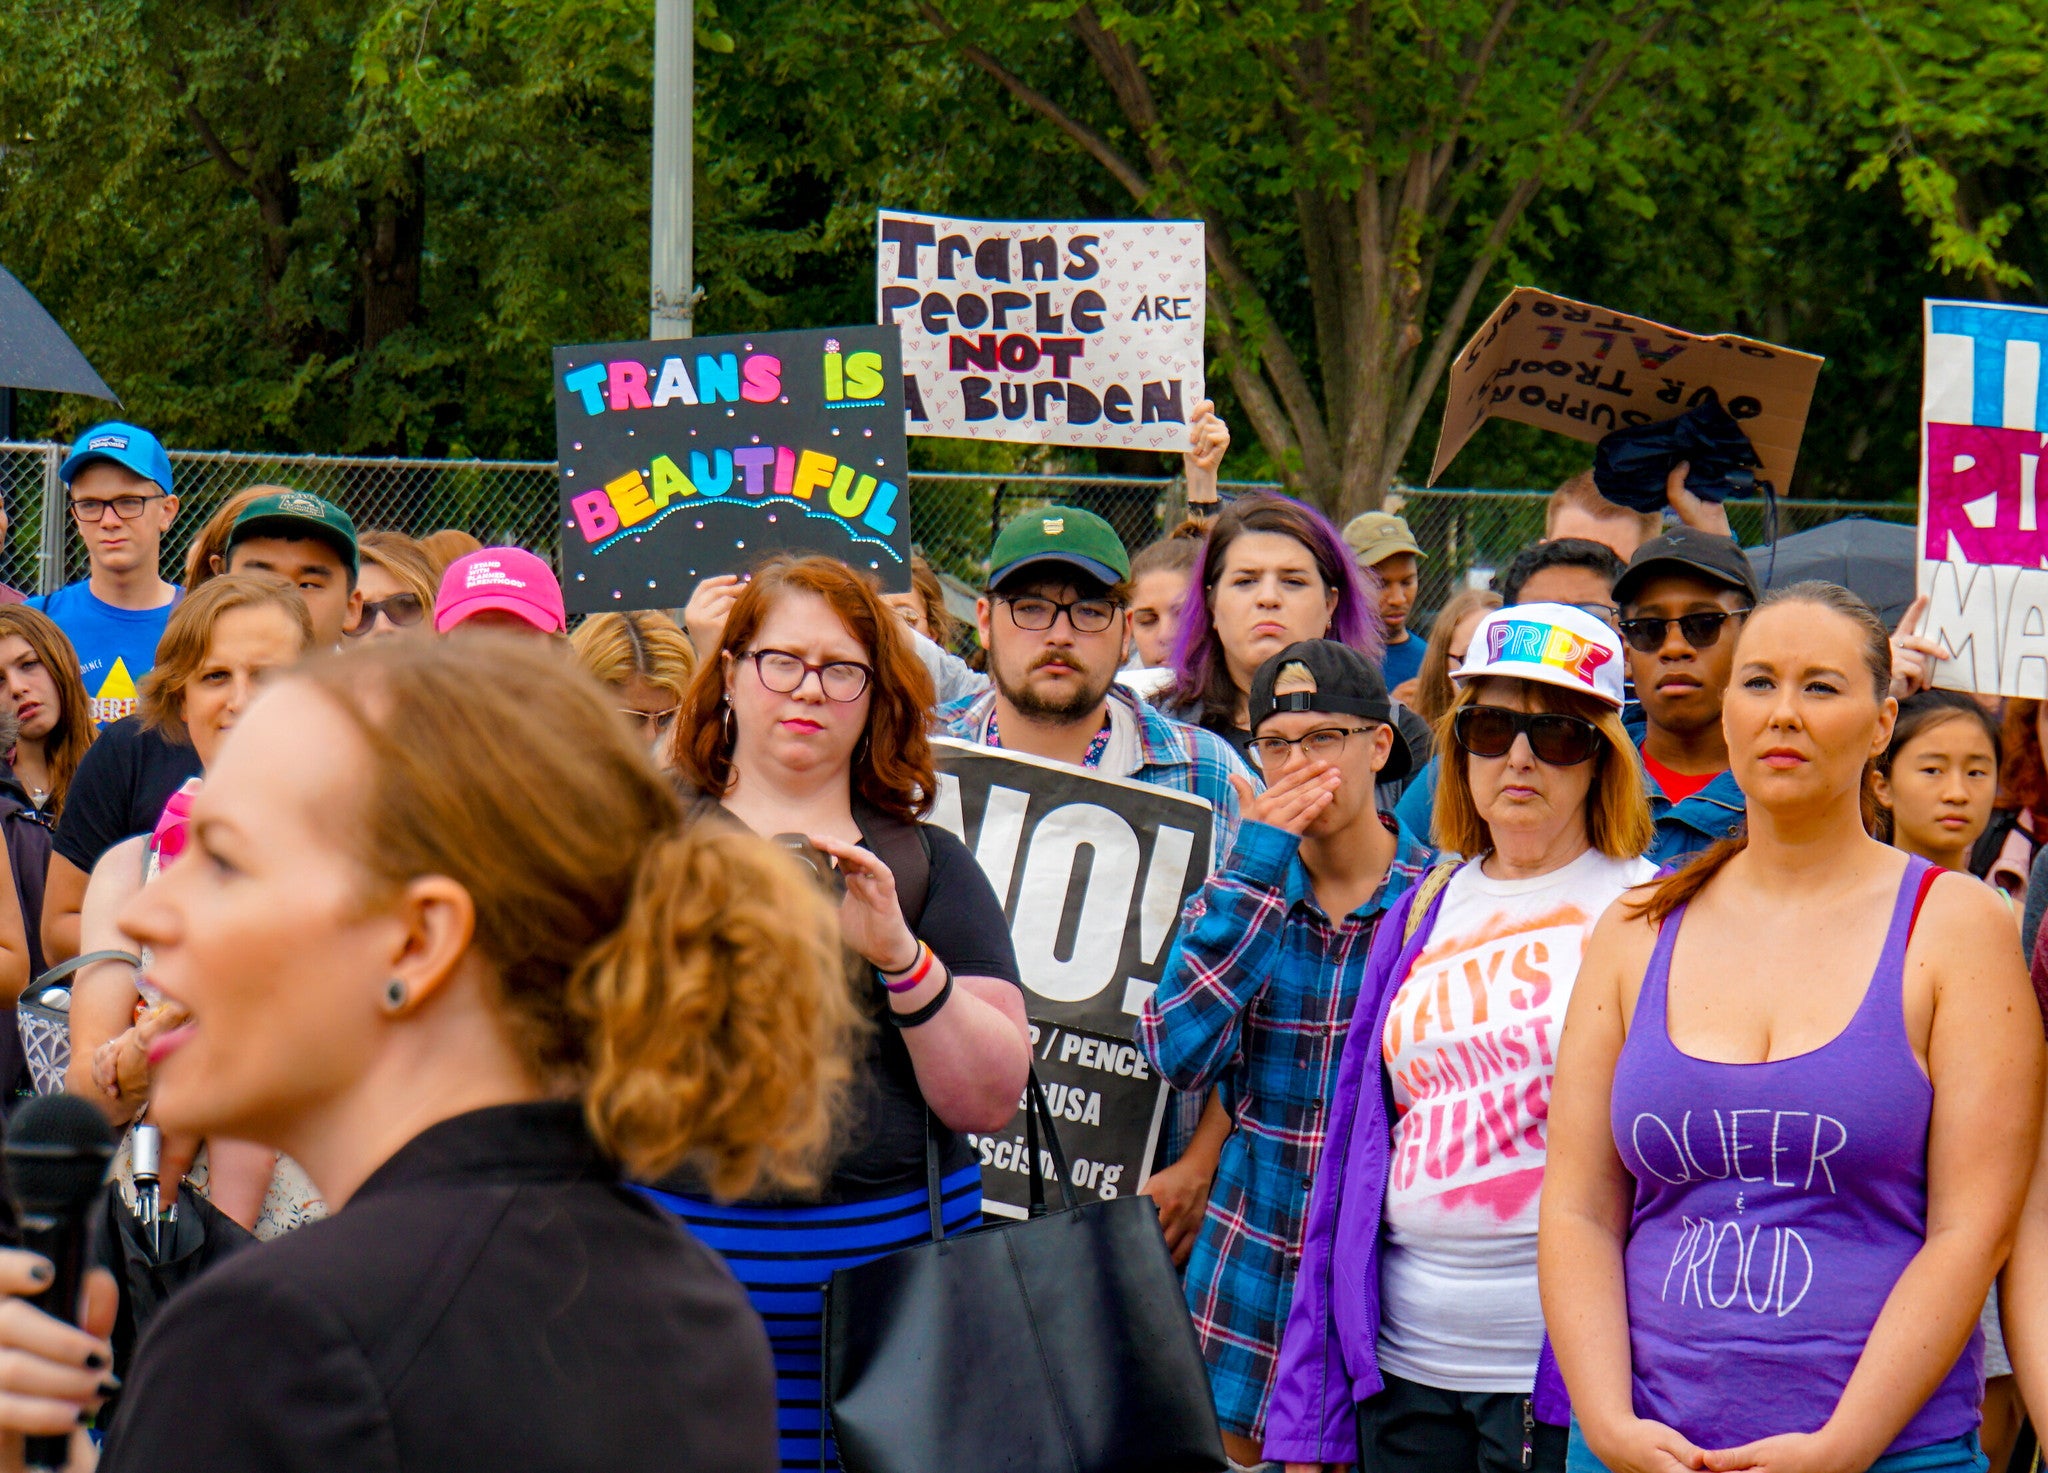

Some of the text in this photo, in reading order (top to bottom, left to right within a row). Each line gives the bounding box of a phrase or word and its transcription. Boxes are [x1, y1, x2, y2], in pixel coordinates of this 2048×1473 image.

[1131, 295, 1192, 322] ARE
[949, 333, 1085, 379] NOT
[1535, 325, 1688, 371] ALL
[563, 346, 886, 416] TRANS IS
[571, 445, 900, 544] BEAUTIFUL
[467, 572, 506, 582] PLANNED
[1490, 624, 1609, 680] PRIDE
[1059, 1032, 1150, 1081] PENCE
[1632, 1108, 1847, 1194] QUEER
[1661, 1215, 1813, 1317] PROUD
